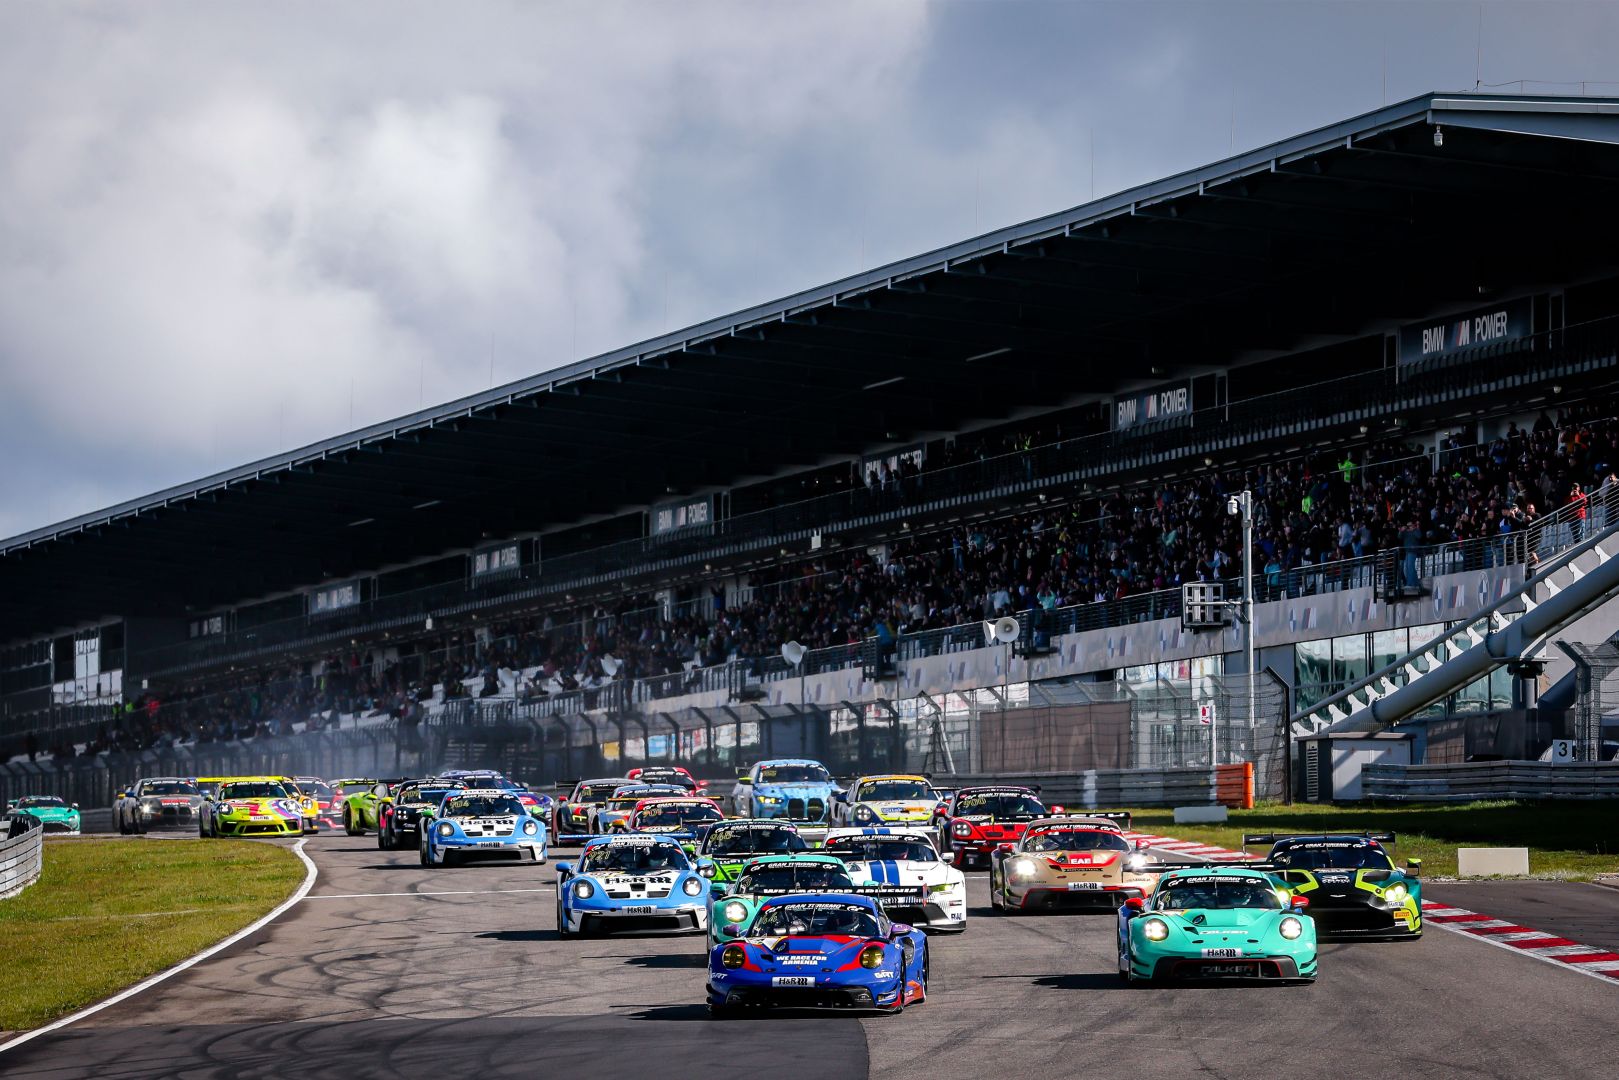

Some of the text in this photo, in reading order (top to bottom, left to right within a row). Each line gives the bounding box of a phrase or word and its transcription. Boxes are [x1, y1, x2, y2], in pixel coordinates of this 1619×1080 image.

[1422, 325, 1445, 355] BMW
[1475, 311, 1508, 343] POWER
[1118, 398, 1137, 425] BMW
[1161, 387, 1187, 415] POWER
[688, 502, 708, 524] POWER
[1558, 741, 1568, 757] 3
[1207, 949, 1225, 957] H&R
[778, 977, 797, 985] H&R
